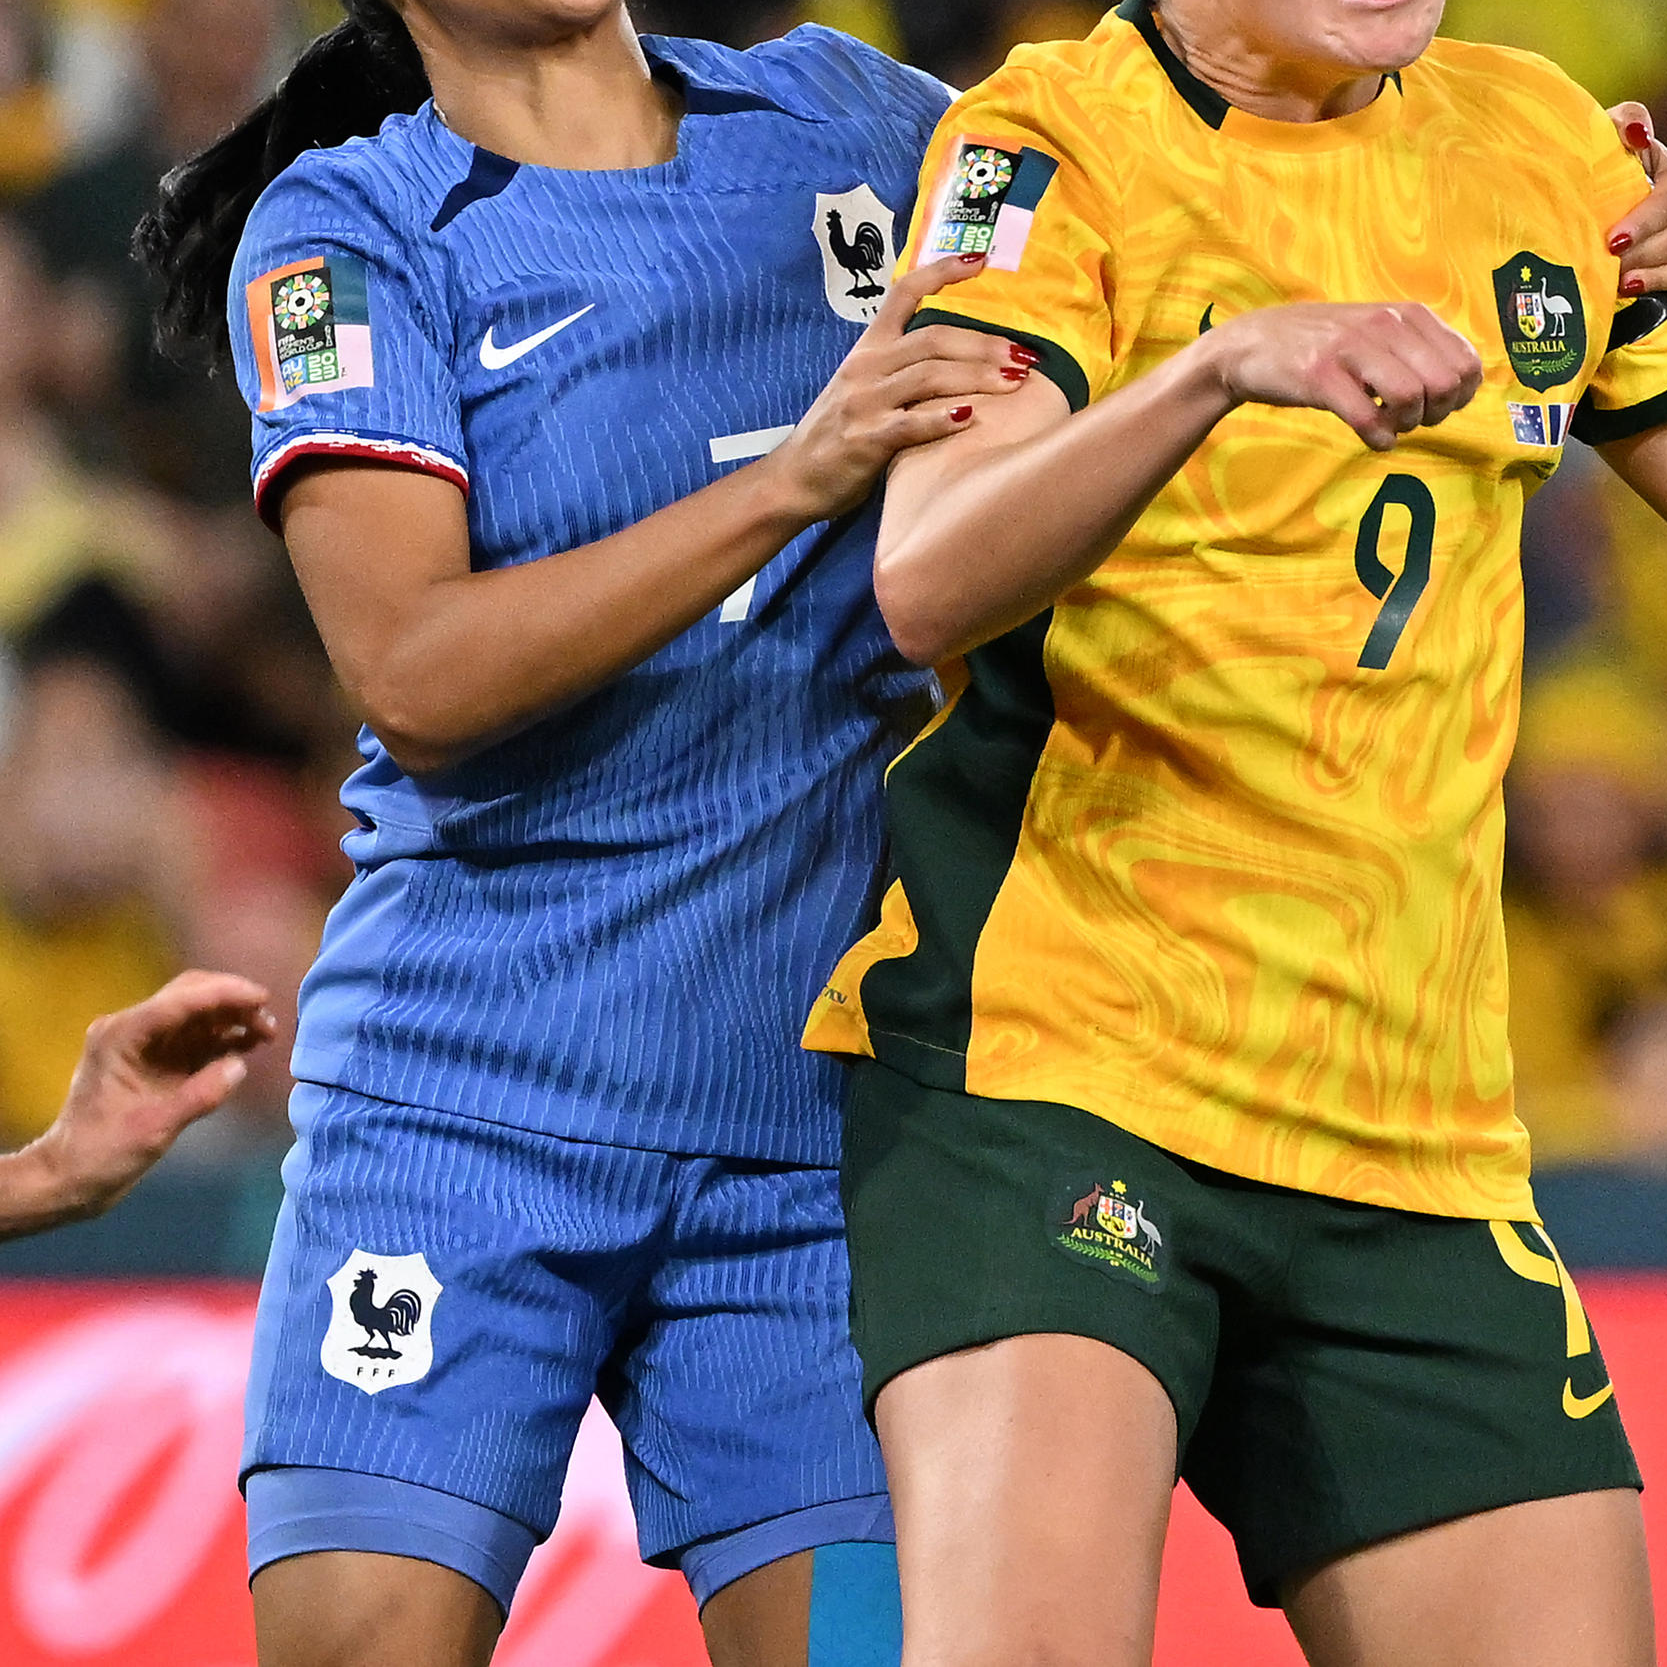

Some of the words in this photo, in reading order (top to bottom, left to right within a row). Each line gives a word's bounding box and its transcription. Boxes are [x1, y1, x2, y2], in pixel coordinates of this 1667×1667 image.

[306, 340, 325, 351] CUP
[282, 357, 303, 379] AU
[285, 371, 304, 391] NZ
[1354, 473, 1437, 671] 9
[1071, 1227, 1152, 1270] AUSTRALIA
